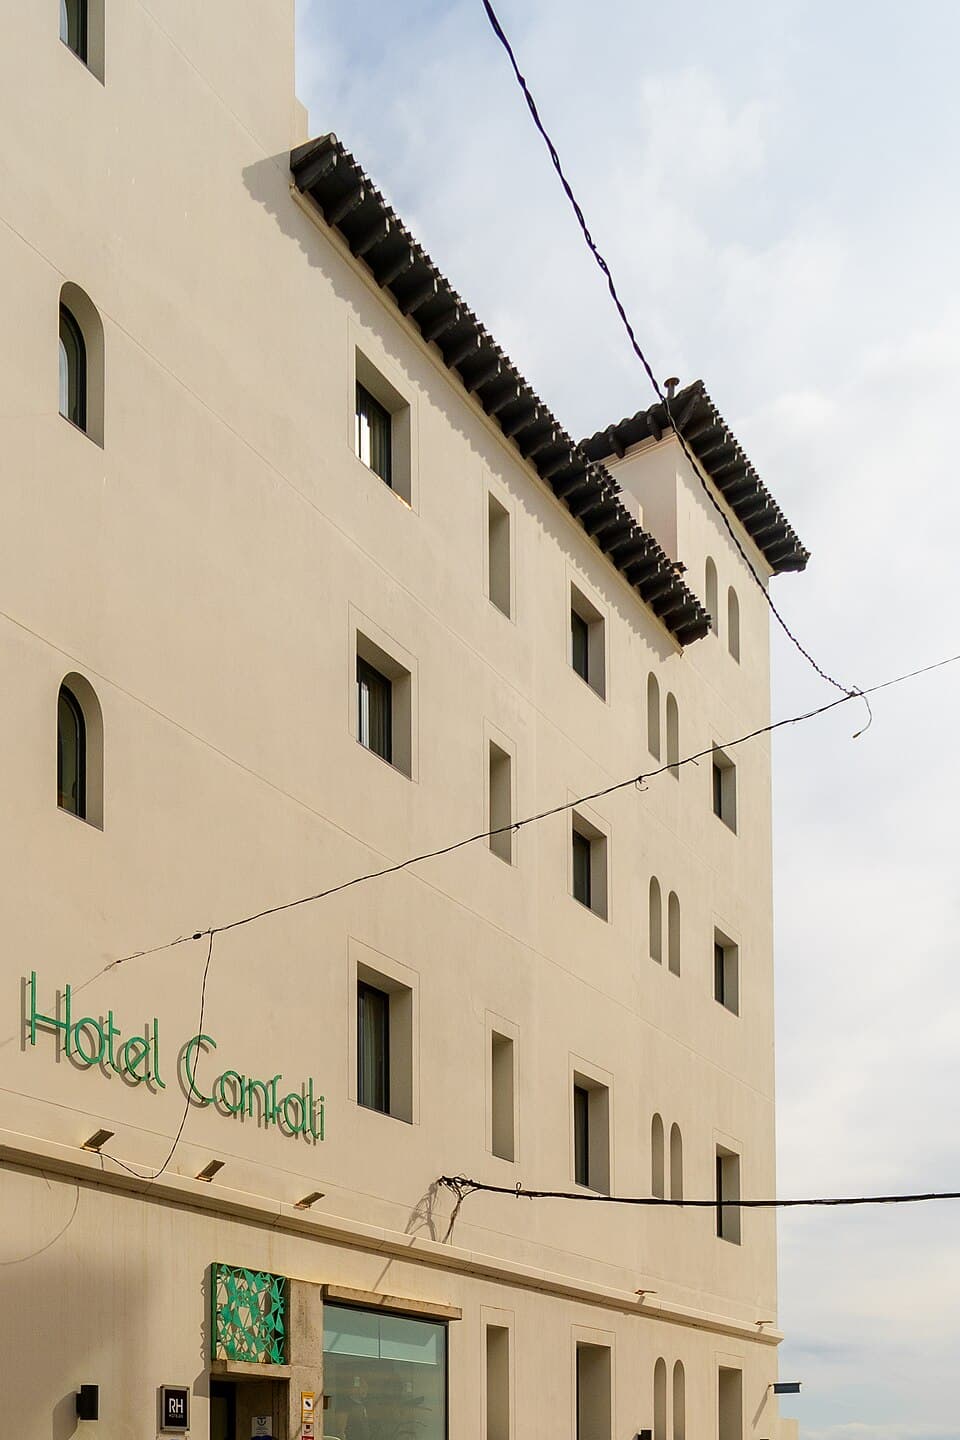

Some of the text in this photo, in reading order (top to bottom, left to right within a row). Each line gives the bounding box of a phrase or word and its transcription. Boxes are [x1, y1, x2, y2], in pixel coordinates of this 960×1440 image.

[30, 970, 166, 1089] Hotel
[185, 1034, 325, 1142] Canfali
[168, 1398, 184, 1414] RH
